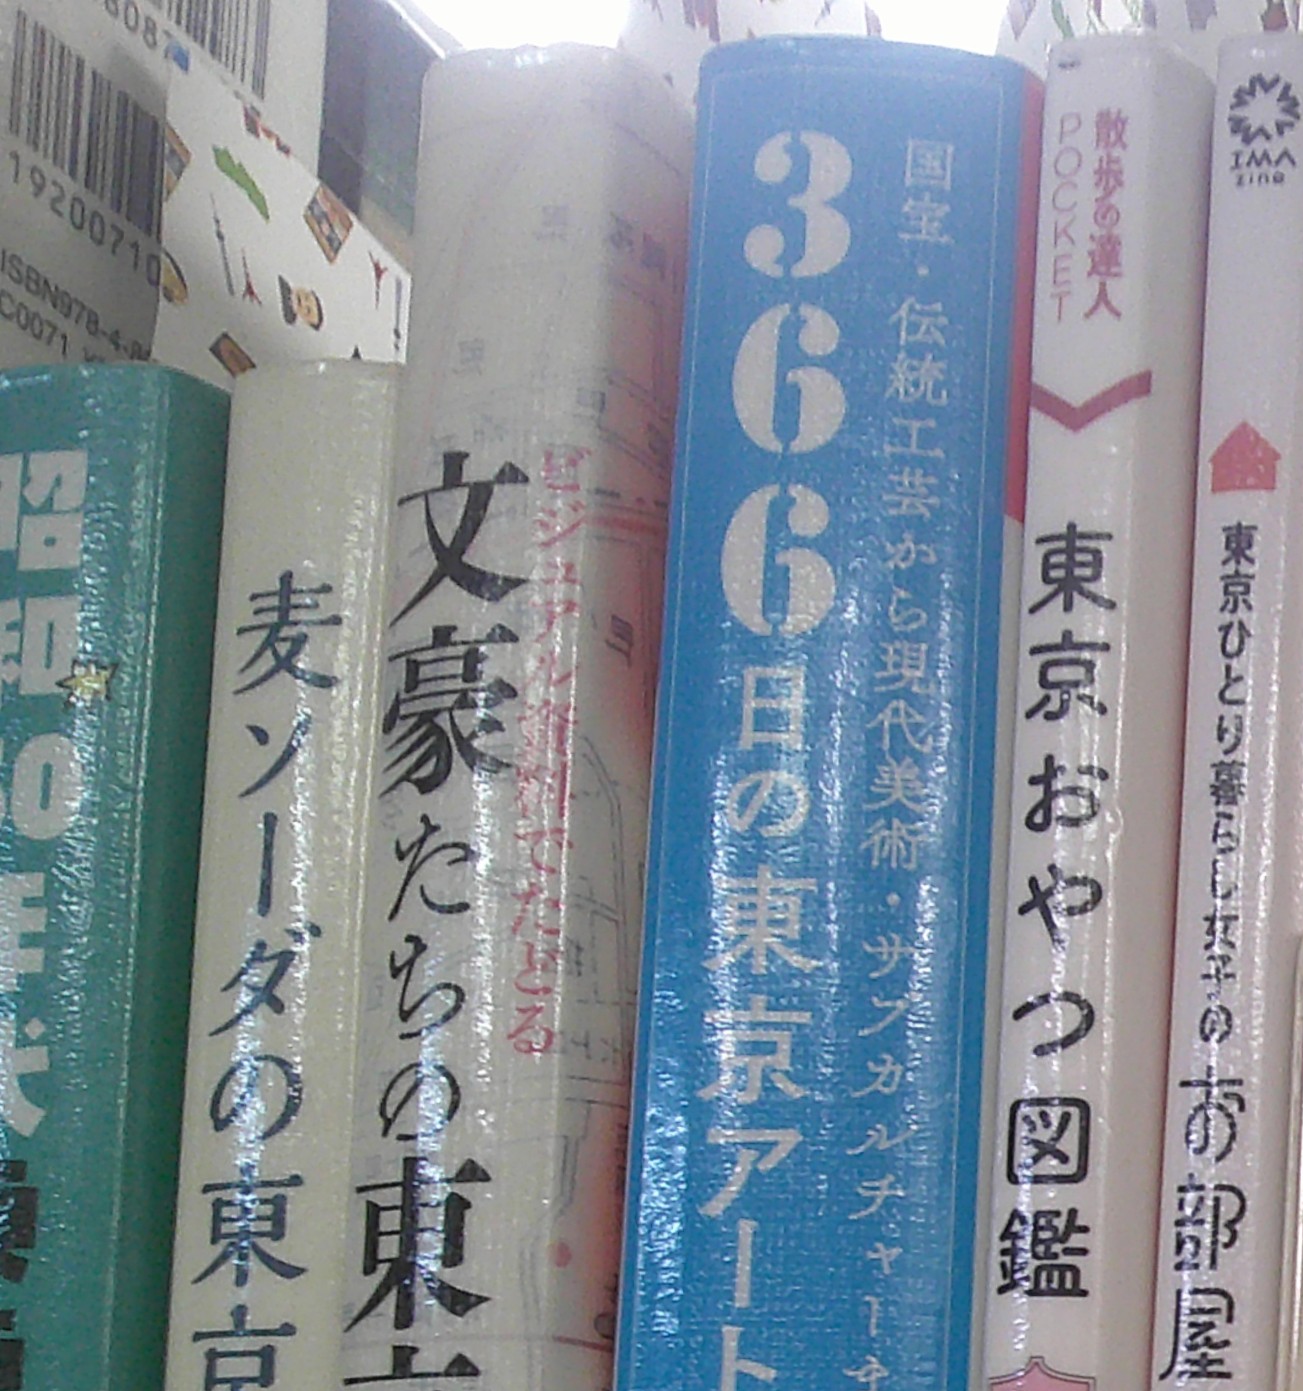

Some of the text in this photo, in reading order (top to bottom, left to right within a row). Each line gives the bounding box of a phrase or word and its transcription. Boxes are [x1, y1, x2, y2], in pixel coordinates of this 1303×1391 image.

[1047, 111, 1083, 325] POCKET
[1085, 107, 1129, 321] 散歩の達人
[997, 521, 1118, 1299] 東京おやつ図鑑
